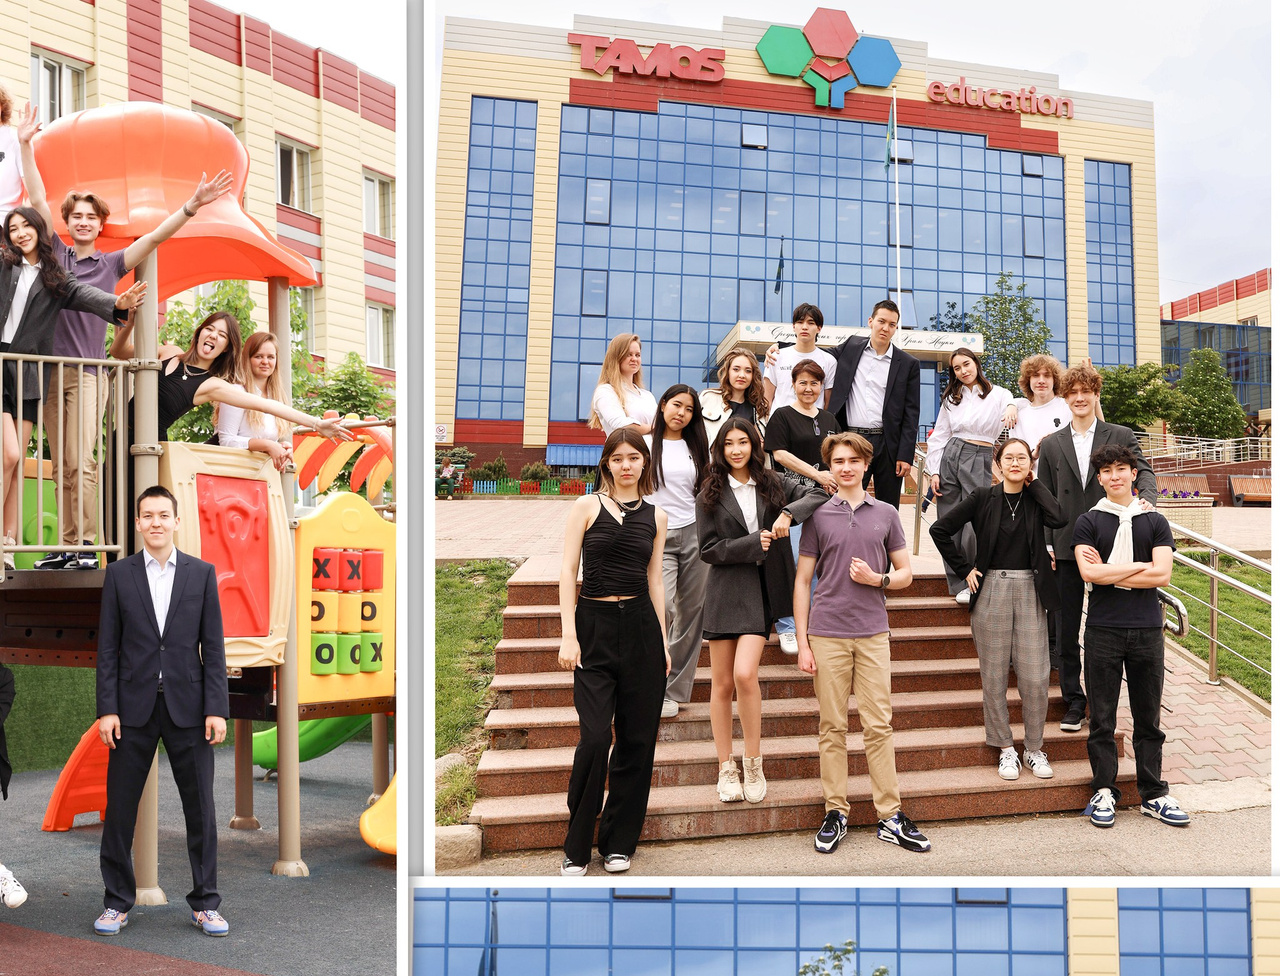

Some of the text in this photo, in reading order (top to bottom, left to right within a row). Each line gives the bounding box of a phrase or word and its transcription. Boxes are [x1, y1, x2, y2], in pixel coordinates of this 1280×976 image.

[568, 33, 725, 83] TAMOS
[927, 76, 1074, 120] education
[313, 558, 362, 580] X X
[315, 643, 335, 665] O
